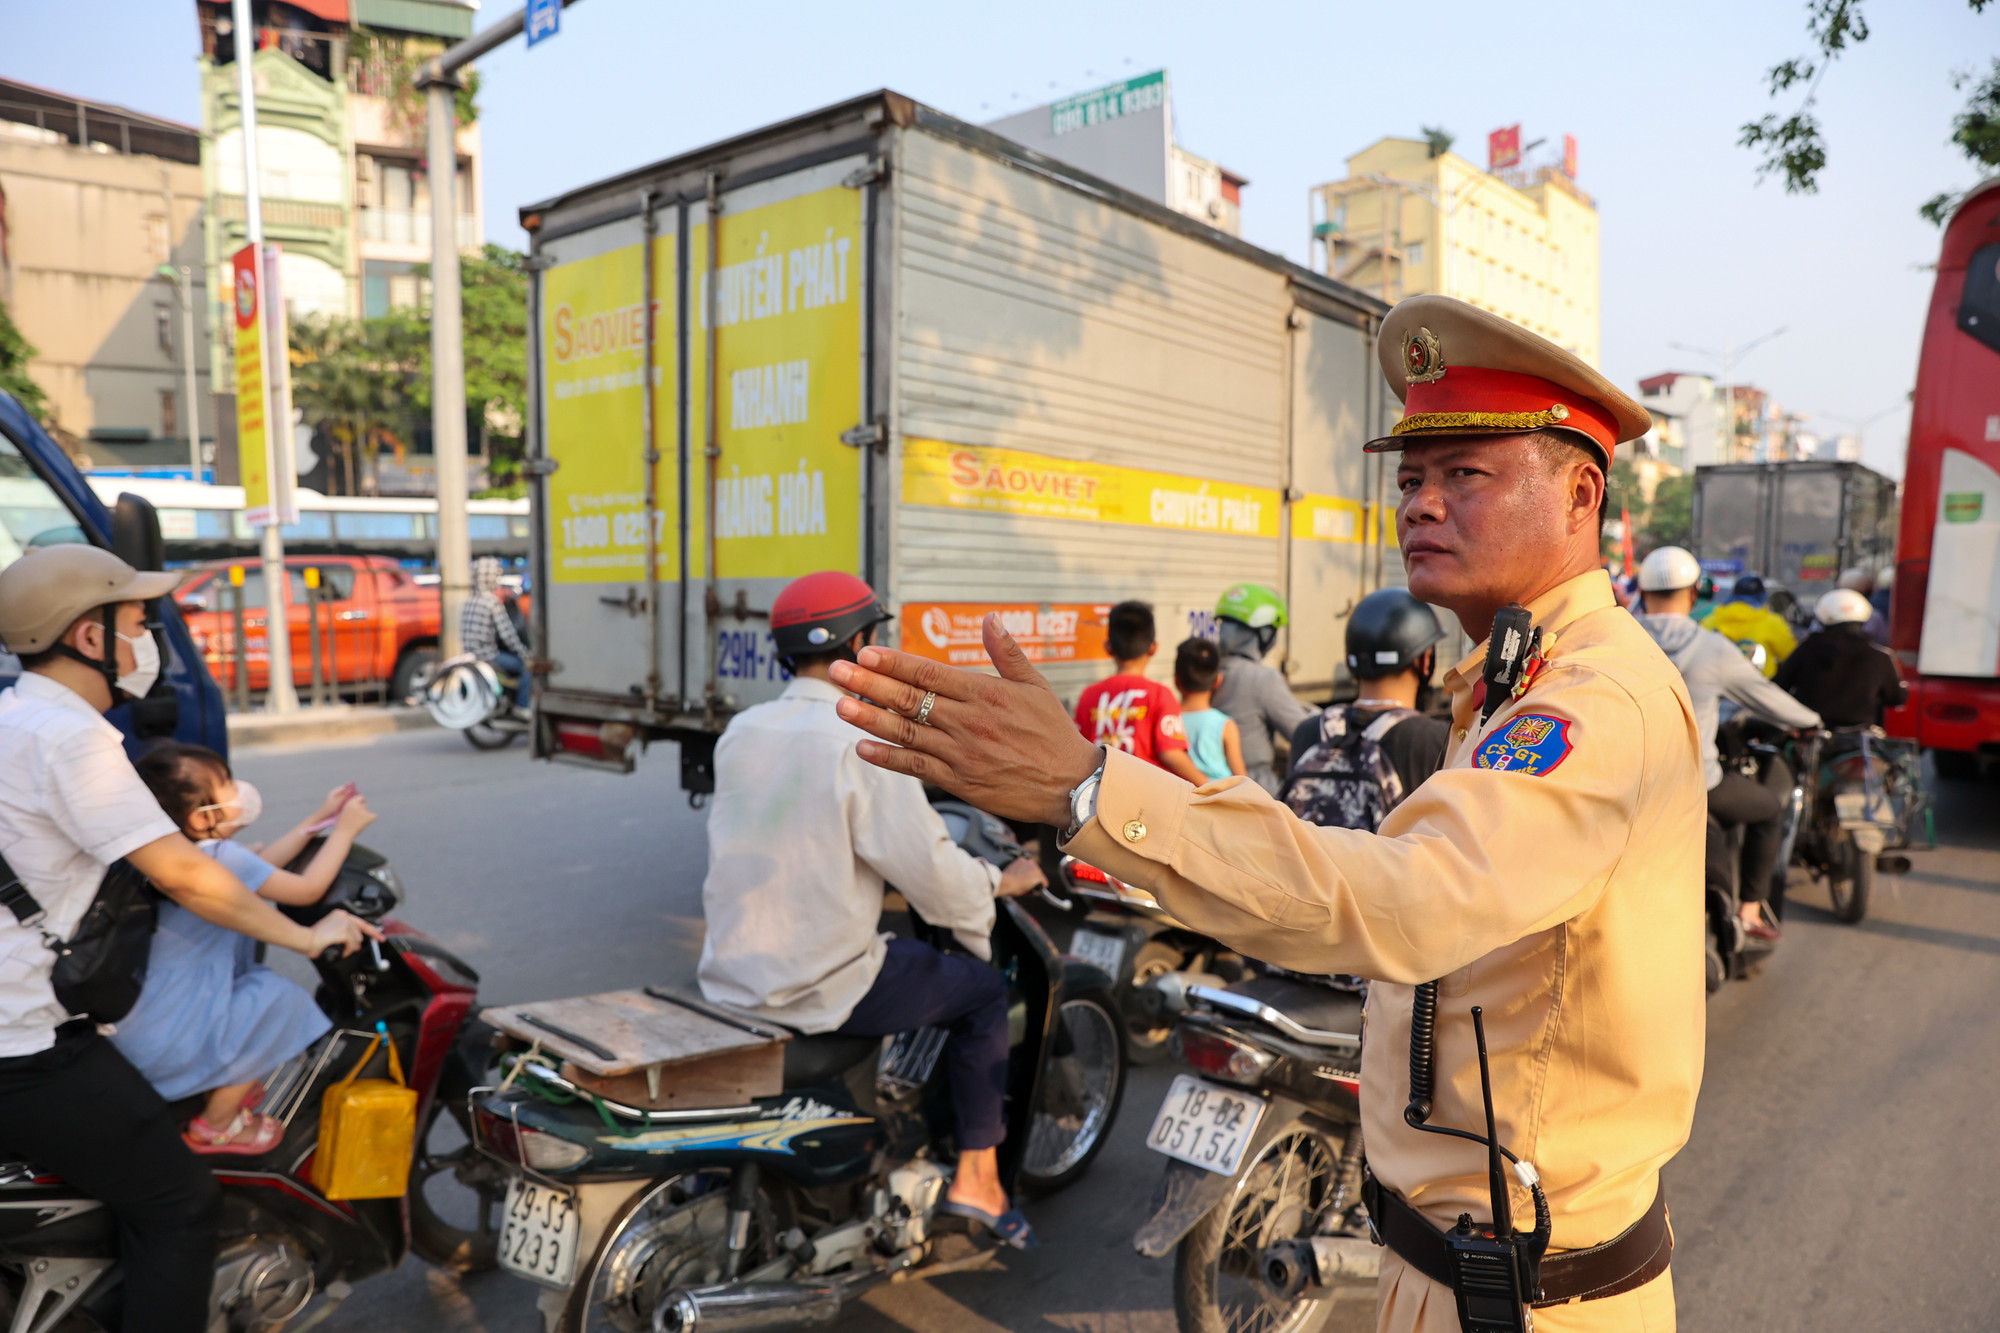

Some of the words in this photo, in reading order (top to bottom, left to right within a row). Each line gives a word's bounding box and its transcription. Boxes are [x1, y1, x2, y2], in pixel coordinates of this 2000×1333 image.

[788, 226, 851, 313] PHÁT
[731, 358, 809, 431] NHANH
[714, 464, 774, 539] HÀNG
[778, 458, 827, 536] HÓA
[1221, 494, 1261, 535] PHÁT
[1485, 744, 1509, 755] CS
[1515, 748, 1542, 765] GT
[1156, 1116, 1237, 1169] 051.54
[503, 1222, 560, 1275] 5233
